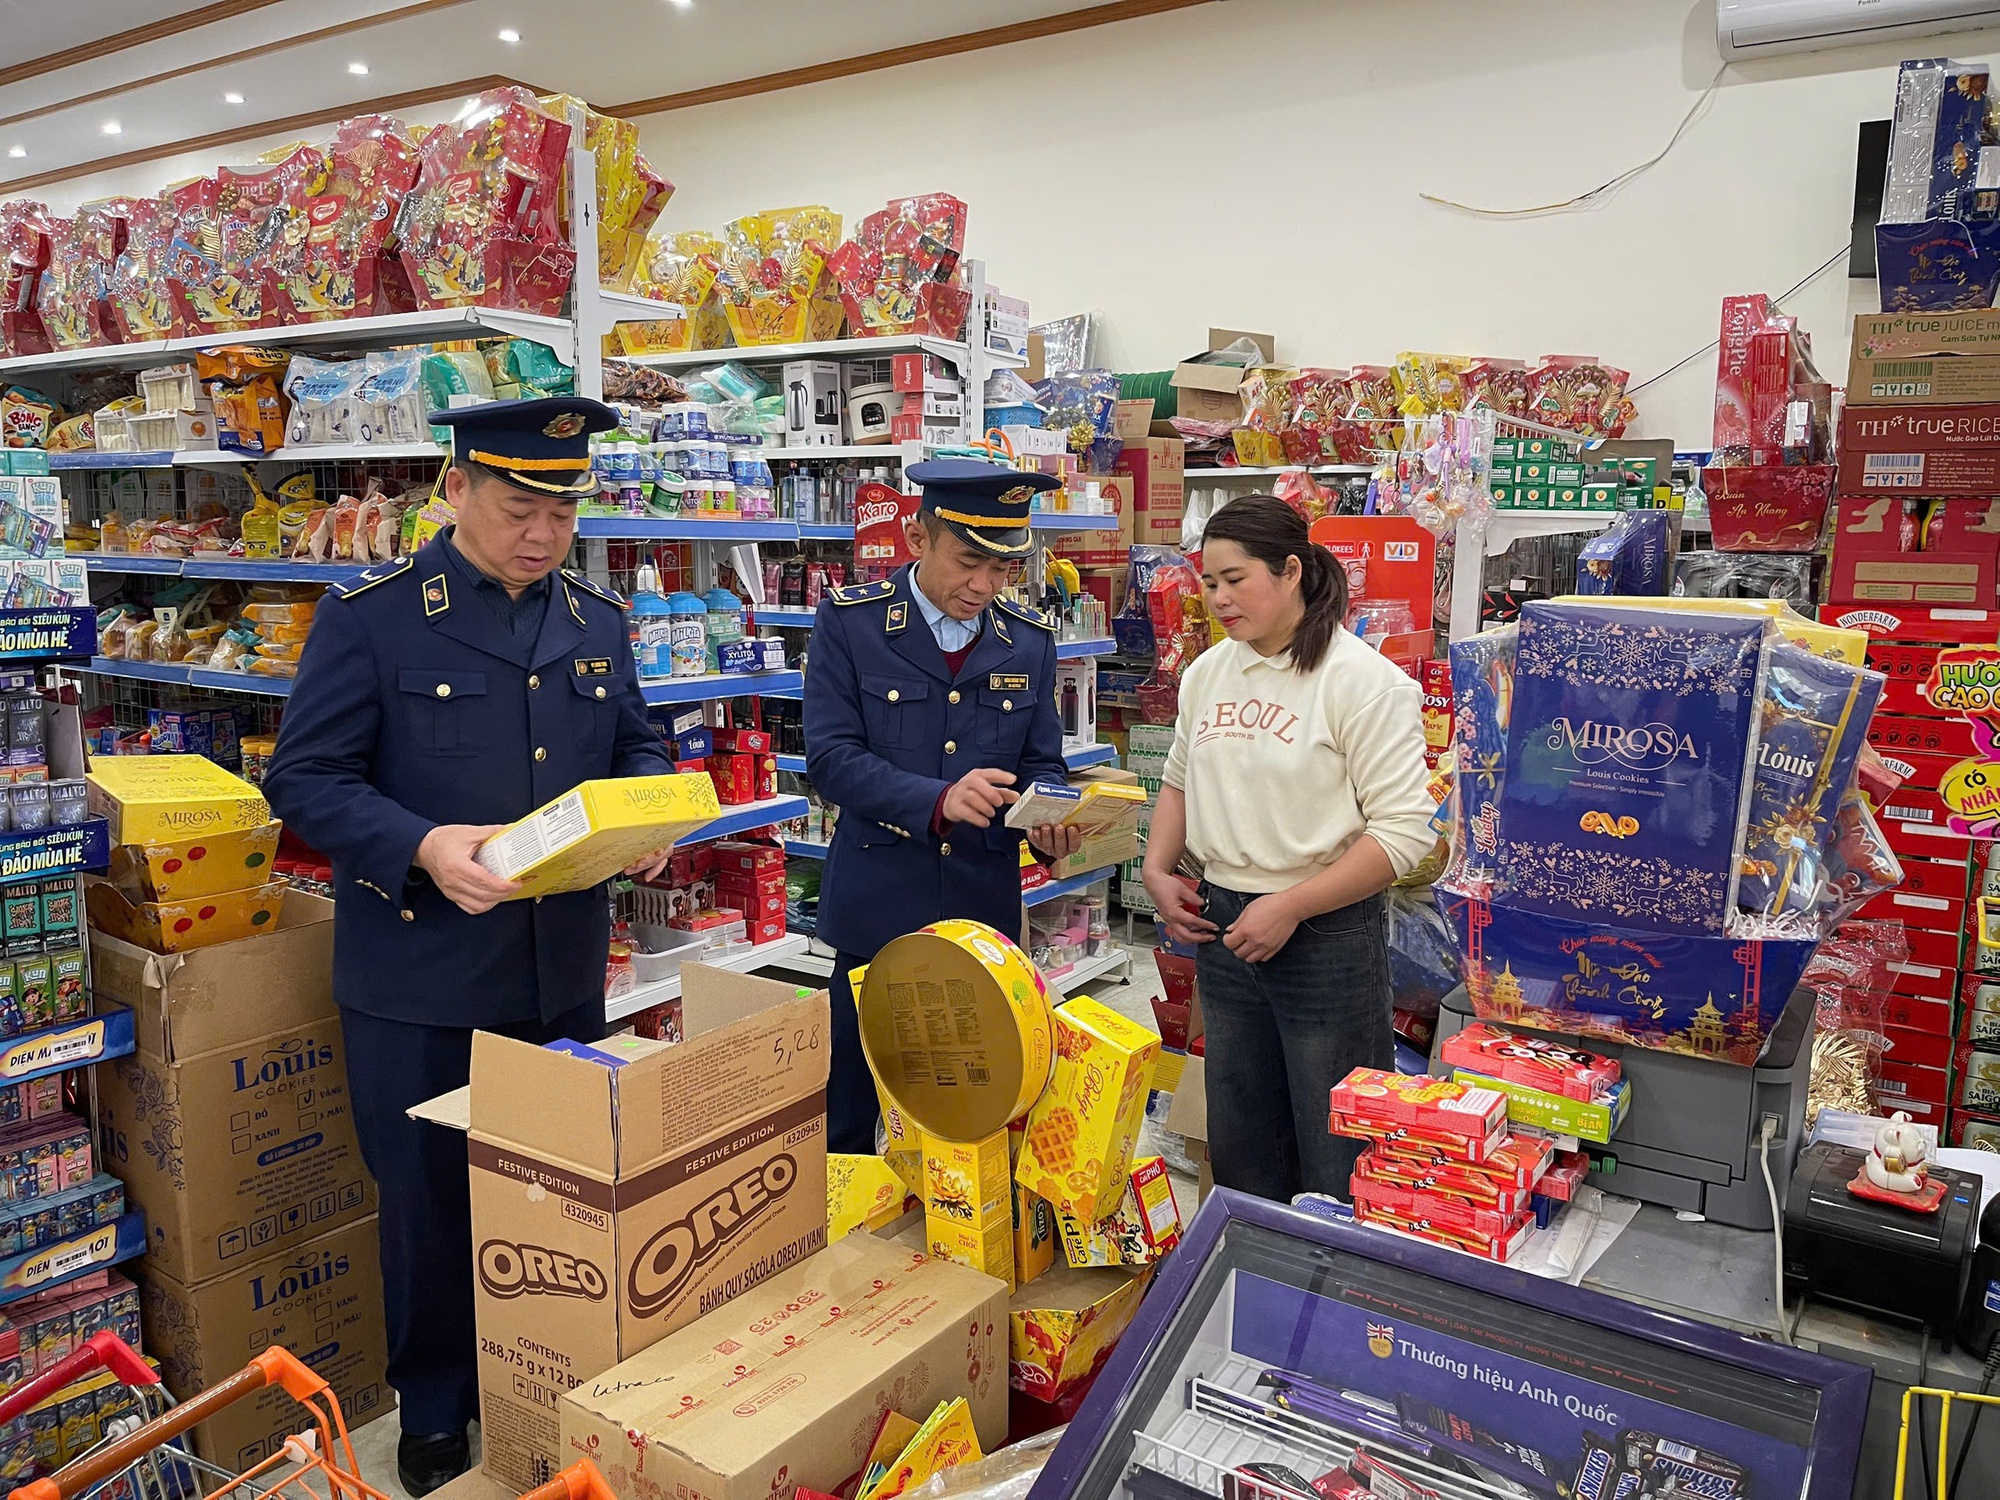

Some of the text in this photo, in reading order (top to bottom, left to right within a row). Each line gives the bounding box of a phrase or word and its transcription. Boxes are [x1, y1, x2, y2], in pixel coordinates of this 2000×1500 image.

[1869, 318, 1986, 335] TH true JUICE
[1941, 335, 1960, 344] Cam
[1856, 420, 1889, 437] TH
[1907, 416, 1954, 435] true
[858, 502, 899, 522] Karo
[1839, 611, 1897, 629] WONDERFARM
[17, 628, 49, 650] MÙA
[1942, 660, 2000, 688] HƯƠ
[11, 698, 43, 712] MALTO
[1934, 687, 1990, 710] CAO
[1547, 717, 1699, 770] MIROSA
[1757, 742, 1817, 778] Louis
[1568, 780, 1592, 788] Premium
[1592, 783, 1617, 791] Selection
[1587, 768, 1650, 784] Louis Cookies
[1964, 769, 1987, 788] CÓ
[13, 787, 48, 802] MALTO
[52, 785, 87, 799] MALTO
[623, 784, 678, 811] MIROSA
[158, 808, 222, 830] MIROSA
[1473, 800, 1501, 857] Lucky
[34, 846, 64, 871] MÙA
[6, 884, 37, 898] MALTO
[44, 879, 74, 893] MALTO
[230, 1039, 334, 1093] Louis
[254, 1074, 317, 1101] COOKIES
[1968, 1091, 2000, 1102] SAIGO
[785, 1119, 820, 1146] 4320945
[685, 1123, 775, 1174] FESTIVE EDITION
[497, 1158, 580, 1196] FESTIVE EDITION
[564, 1202, 605, 1228] 4320945
[628, 1154, 797, 1317] OREO
[248, 1251, 350, 1311] Louis
[481, 1241, 606, 1299] OREO
[699, 1285, 724, 1315] BÁNH
[725, 1272, 743, 1300] QUY
[744, 1256, 776, 1288] SÔCÔLA
[776, 1243, 799, 1268] OREO
[806, 1225, 825, 1250] VANI
[272, 1286, 333, 1316] COOKIES
[1434, 1314, 1449, 1326] NOT
[1449, 1320, 1469, 1333] LOAD
[1470, 1326, 1485, 1337] THE
[1485, 1331, 1524, 1349] PRODUCTS
[481, 1337, 585, 1390] 288,75 g x 12 BO
[517, 1336, 572, 1368] CONTENTS
[1398, 1339, 1619, 1427] Thương hiệu Anh Quốc
[1653, 1456, 1735, 1494] SNICKERS
